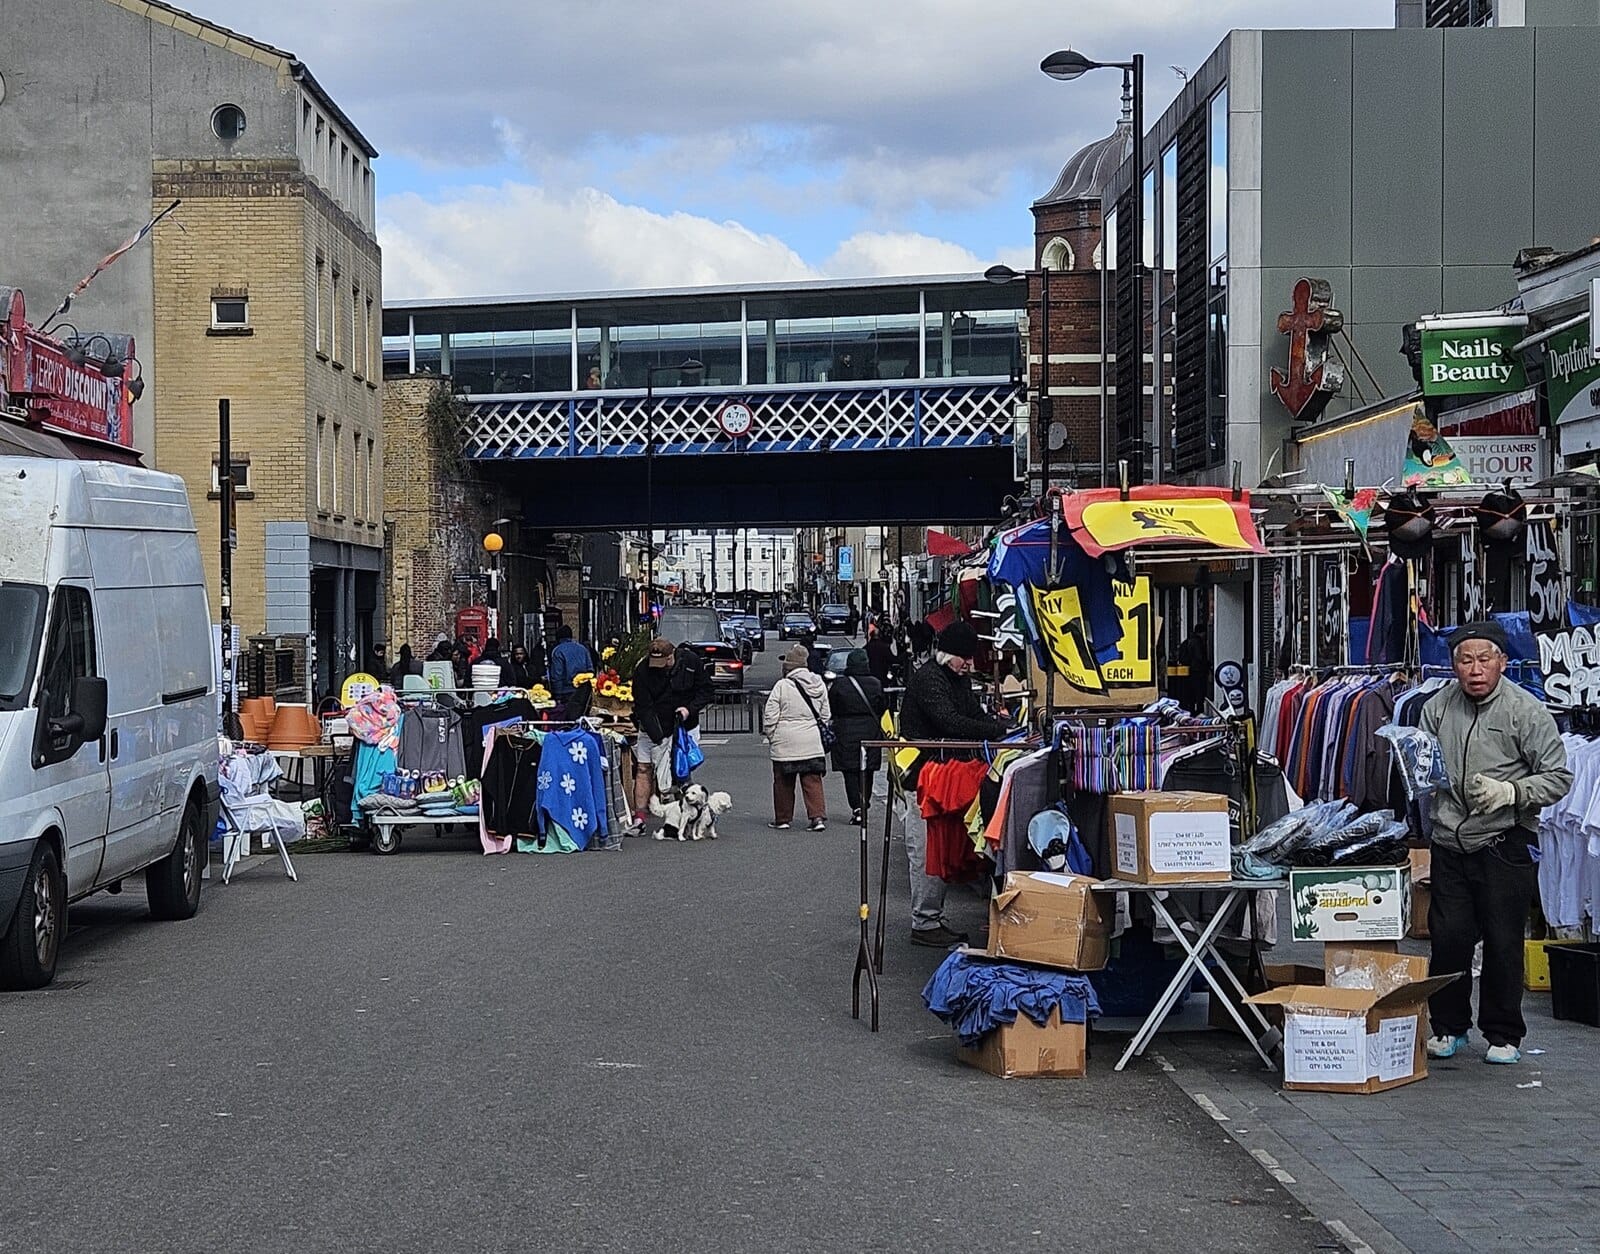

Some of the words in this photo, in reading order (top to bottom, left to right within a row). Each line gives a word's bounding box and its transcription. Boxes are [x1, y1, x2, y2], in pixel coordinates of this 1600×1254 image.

[1440, 338, 1503, 359] Nails
[35, 354, 63, 394] TERRY'S
[65, 366, 107, 411] DISCOUNT
[1430, 364, 1514, 384] Beauty
[726, 411, 747, 419] 4.7m
[1469, 444, 1488, 454] DRY
[1490, 443, 1536, 454] CLEANERS
[1469, 455, 1534, 474] HOUR
[1526, 522, 1556, 562] ALL
[1113, 583, 1134, 598] NLY
[1107, 668, 1133, 680] EACH
